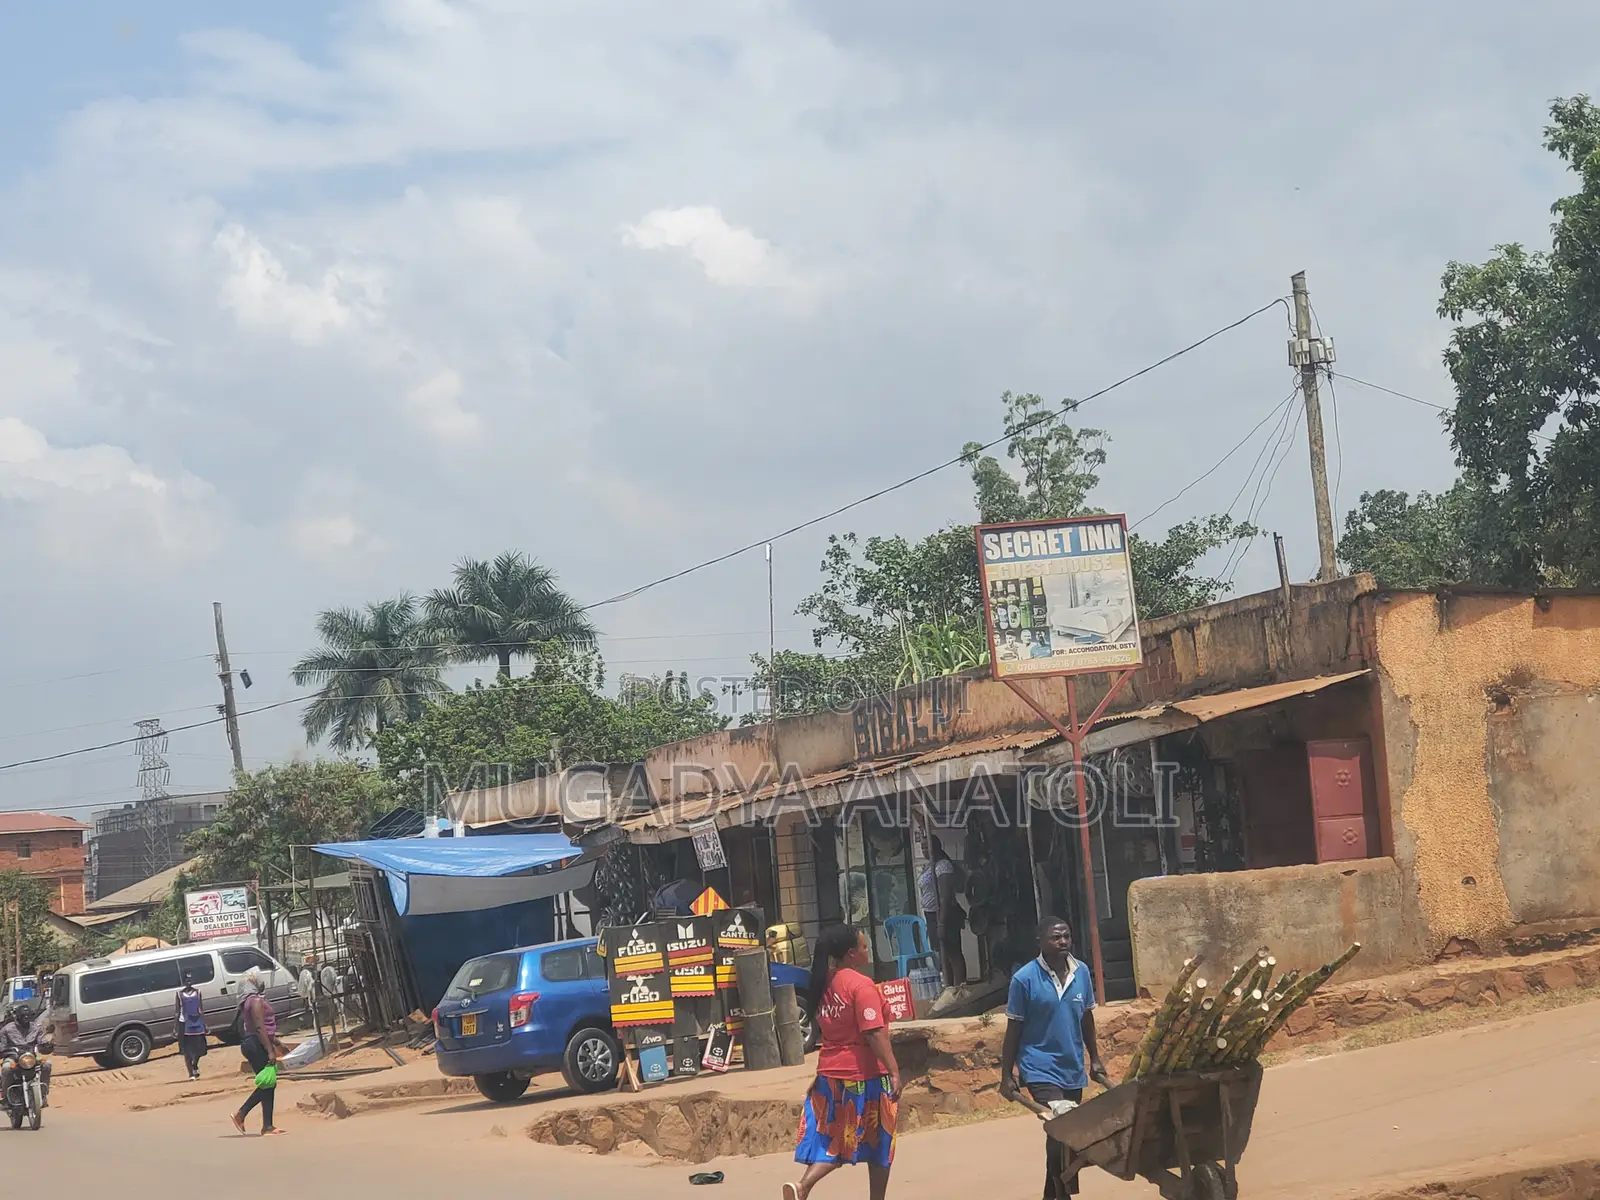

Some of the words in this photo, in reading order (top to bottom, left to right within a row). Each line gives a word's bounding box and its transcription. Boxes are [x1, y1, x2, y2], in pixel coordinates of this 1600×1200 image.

[984, 527, 1073, 560] SECRET
[1078, 523, 1121, 552] INN
[1000, 560, 1052, 579] GUEST
[1060, 555, 1112, 575] HOUSE
[1119, 641, 1137, 650] DSTV
[192, 916, 214, 925] KABS
[216, 913, 245, 922] MOTOR
[204, 921, 233, 930] DEALERS
[720, 931, 755, 939] CANTER
[618, 942, 657, 957] FUSO
[667, 938, 706, 951] ISUZU
[674, 966, 705, 975] USO
[621, 991, 660, 1004] FUSO
